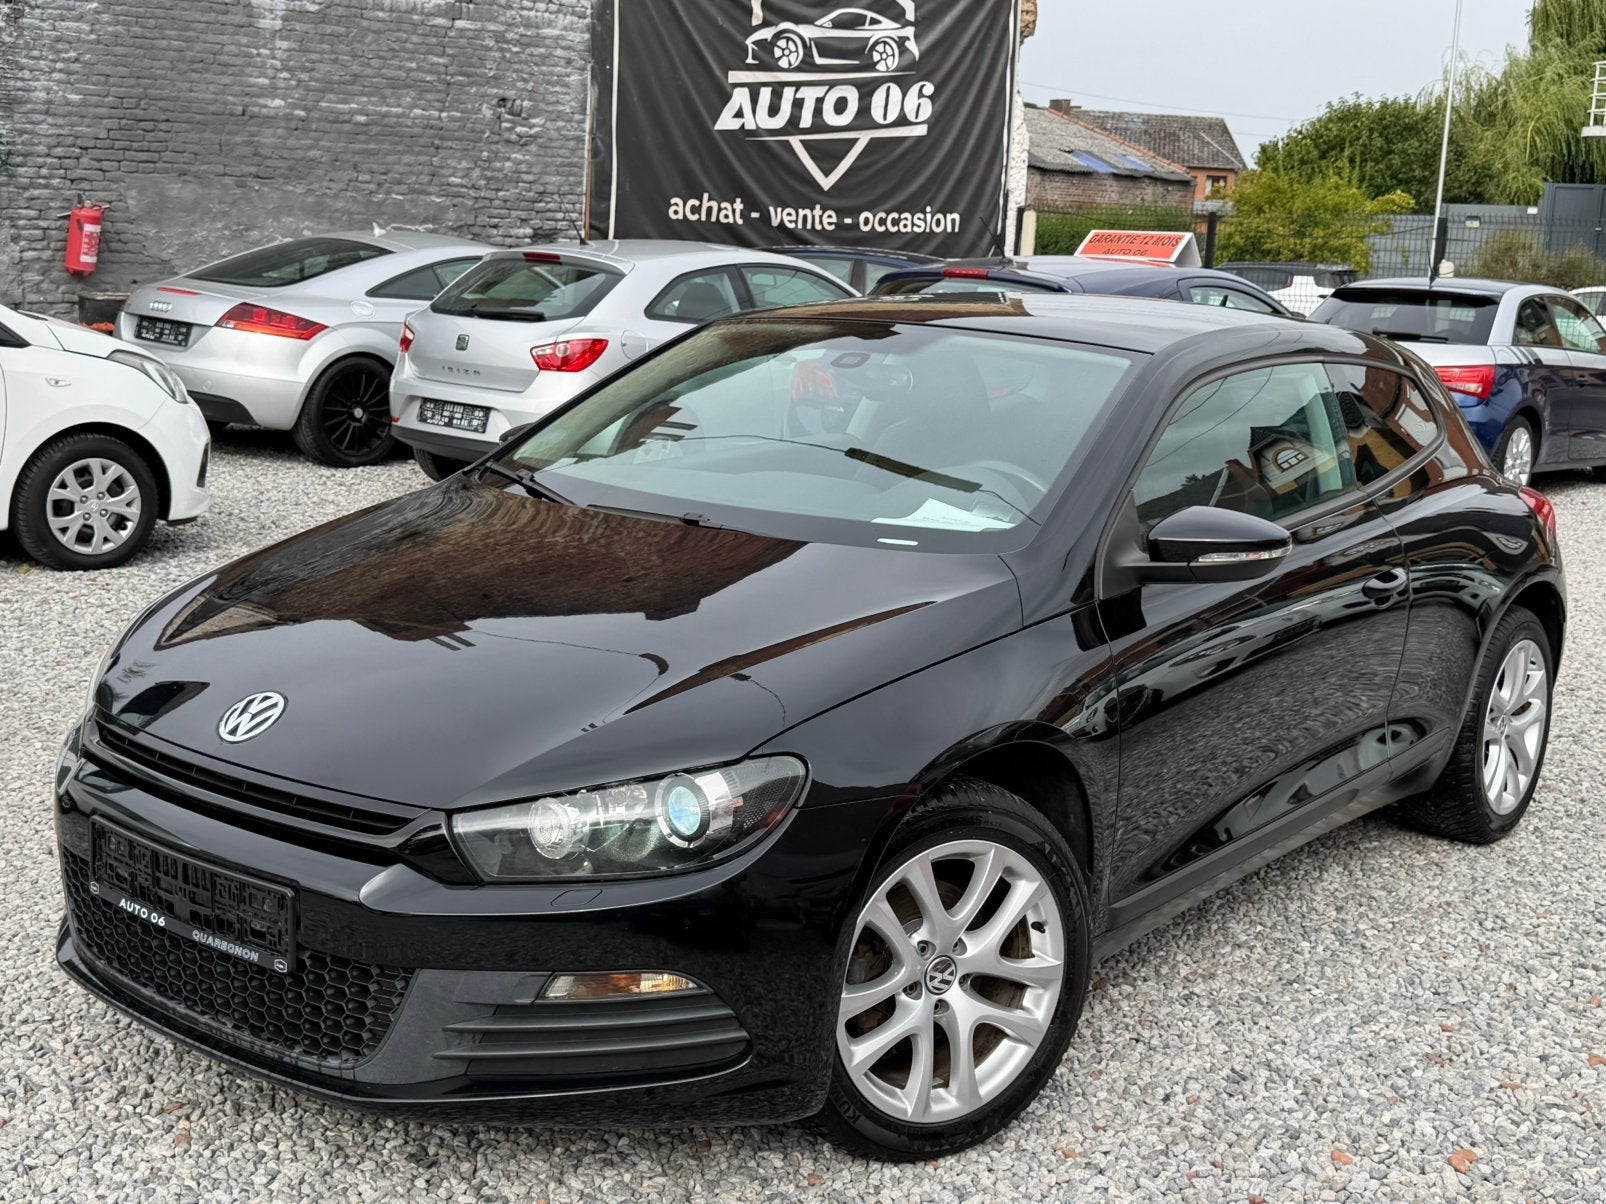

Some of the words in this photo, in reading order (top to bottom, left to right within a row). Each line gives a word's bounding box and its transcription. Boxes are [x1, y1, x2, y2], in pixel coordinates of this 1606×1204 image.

[713, 85, 859, 130] AUTO
[870, 81, 935, 125] 06
[668, 192, 744, 225] achat
[768, 204, 838, 231] vente
[858, 205, 960, 233] occasion
[1089, 234, 1138, 245] GARANTIE
[1138, 235, 1153, 246] 12
[1153, 235, 1182, 247] MOIS
[119, 898, 148, 919] AUTO
[150, 912, 166, 927] 06
[191, 929, 259, 962] QUAREGNON
